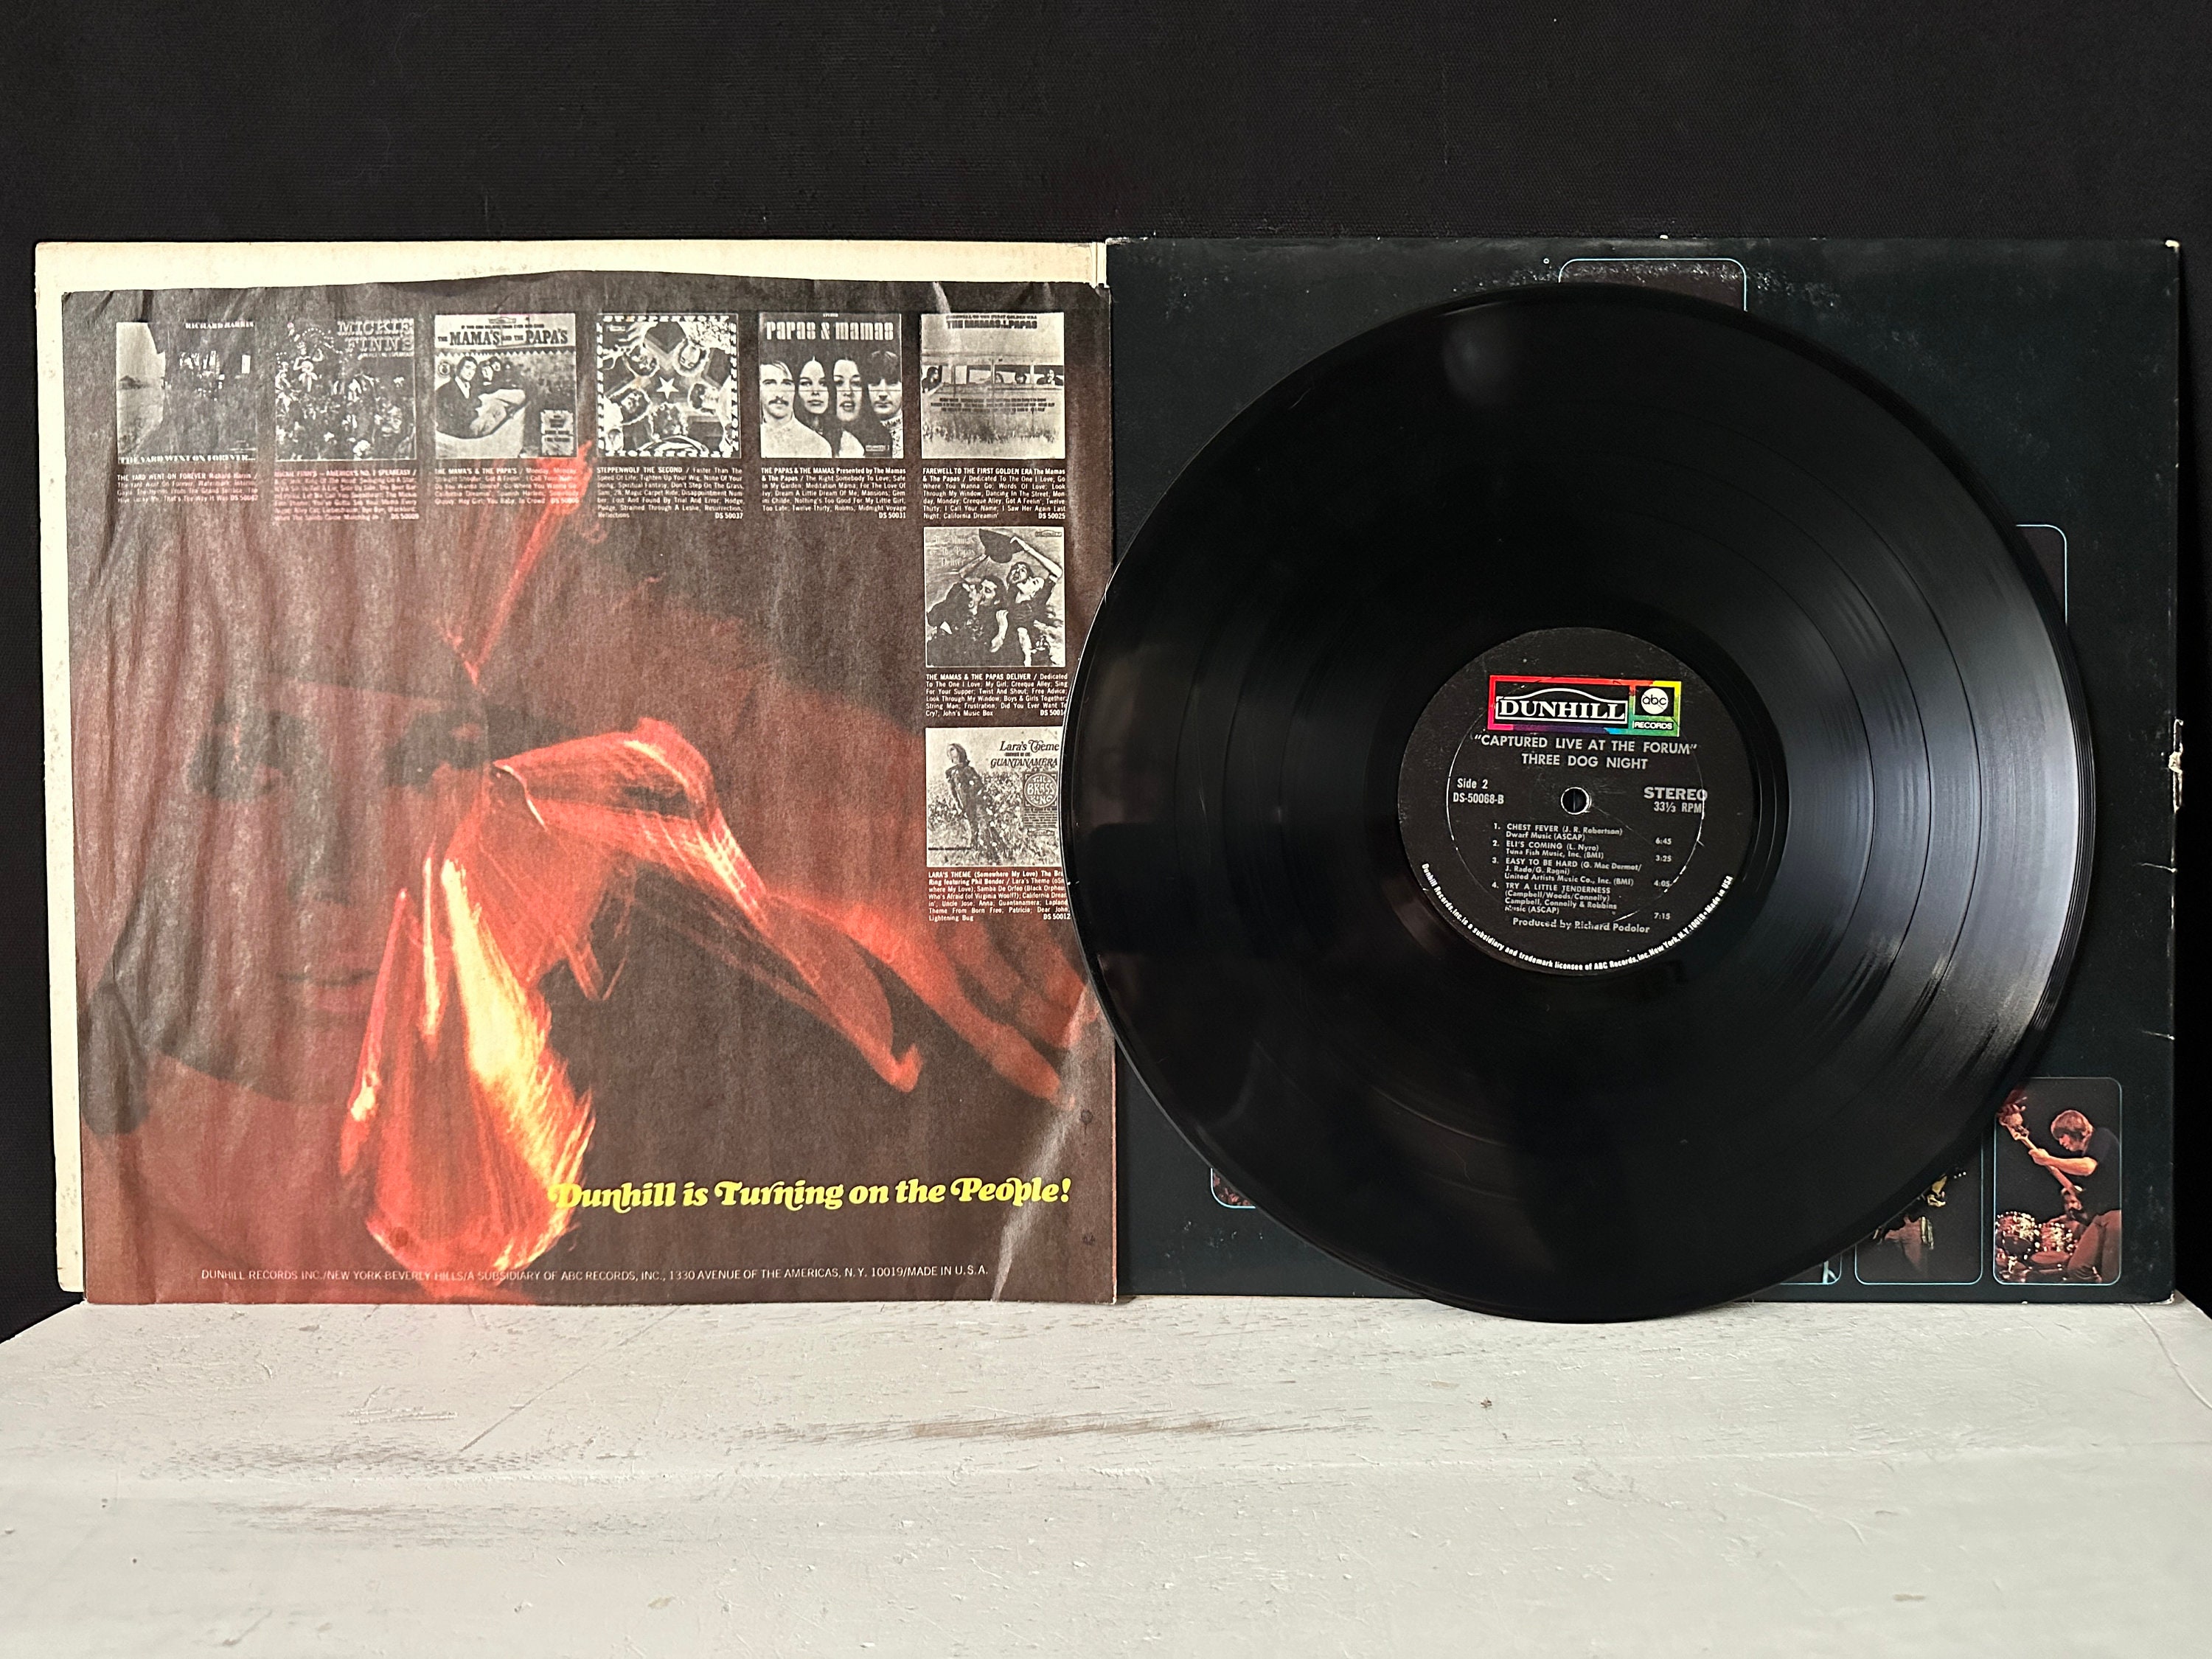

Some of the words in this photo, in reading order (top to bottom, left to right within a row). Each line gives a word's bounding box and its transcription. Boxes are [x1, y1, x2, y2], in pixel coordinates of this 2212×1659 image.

[450, 330, 500, 345] MAMA'S
[526, 330, 568, 344] PAPA'S
[1499, 700, 1625, 720] DUNHILL
[1641, 694, 1668, 705] abc
[1634, 721, 1672, 729] RECORDS
[999, 741, 1027, 751] Lara's
[1556, 737, 1582, 749] LIVE
[1587, 739, 1606, 751] AT
[1610, 740, 1635, 751] THE
[990, 758, 1057, 768] GUANTANAMERA
[1522, 754, 1560, 765] THREE
[1568, 755, 1599, 767] DOG
[1606, 757, 1648, 770] NIGHT
[1457, 779, 1476, 789] Side
[1482, 779, 1488, 789] 2
[1453, 793, 1504, 804] DS-50068-B
[1644, 787, 1708, 801] STEREO
[1682, 802, 1702, 813] RPM
[1583, 827, 1622, 835] Robertson)
[1528, 841, 1562, 849] COMING
[1578, 844, 1599, 852] Nyro)
[1547, 867, 1570, 875] Ragni)
[1557, 874, 1578, 883] Music
[1613, 877, 1633, 886] (BMI)
[1562, 886, 1610, 894] TENDERNESS
[1545, 900, 1576, 908] Connelly
[1528, 906, 1559, 914] (ASCAP)
[1512, 917, 1557, 928] Produced
[1559, 920, 1571, 930] by
[1574, 921, 1610, 931] Richard
[1613, 923, 1650, 933] Podolor
[1505, 947, 1518, 956] and
[547, 1182, 675, 1213] Dunhill
[683, 1182, 709, 1206] is
[714, 1180, 844, 1211] Turning
[848, 1185, 888, 1204] on
[895, 1179, 946, 1203] the
[950, 1177, 1071, 1206] People!
[201, 1270, 245, 1280] DUNHILL
[248, 1270, 298, 1279] RECORDS
[477, 1271, 540, 1281] SUBSIDIARY
[543, 1271, 558, 1281] OF
[561, 1271, 583, 1281] ABC
[585, 1270, 638, 1281] RECORDS,
[669, 1270, 695, 1280] 1330
[698, 1270, 740, 1279] AVENUE
[743, 1269, 757, 1279] OF
[761, 1268, 782, 1279] THE
[785, 1268, 841, 1279] AMERICAS,
[941, 1266, 952, 1276] IN
